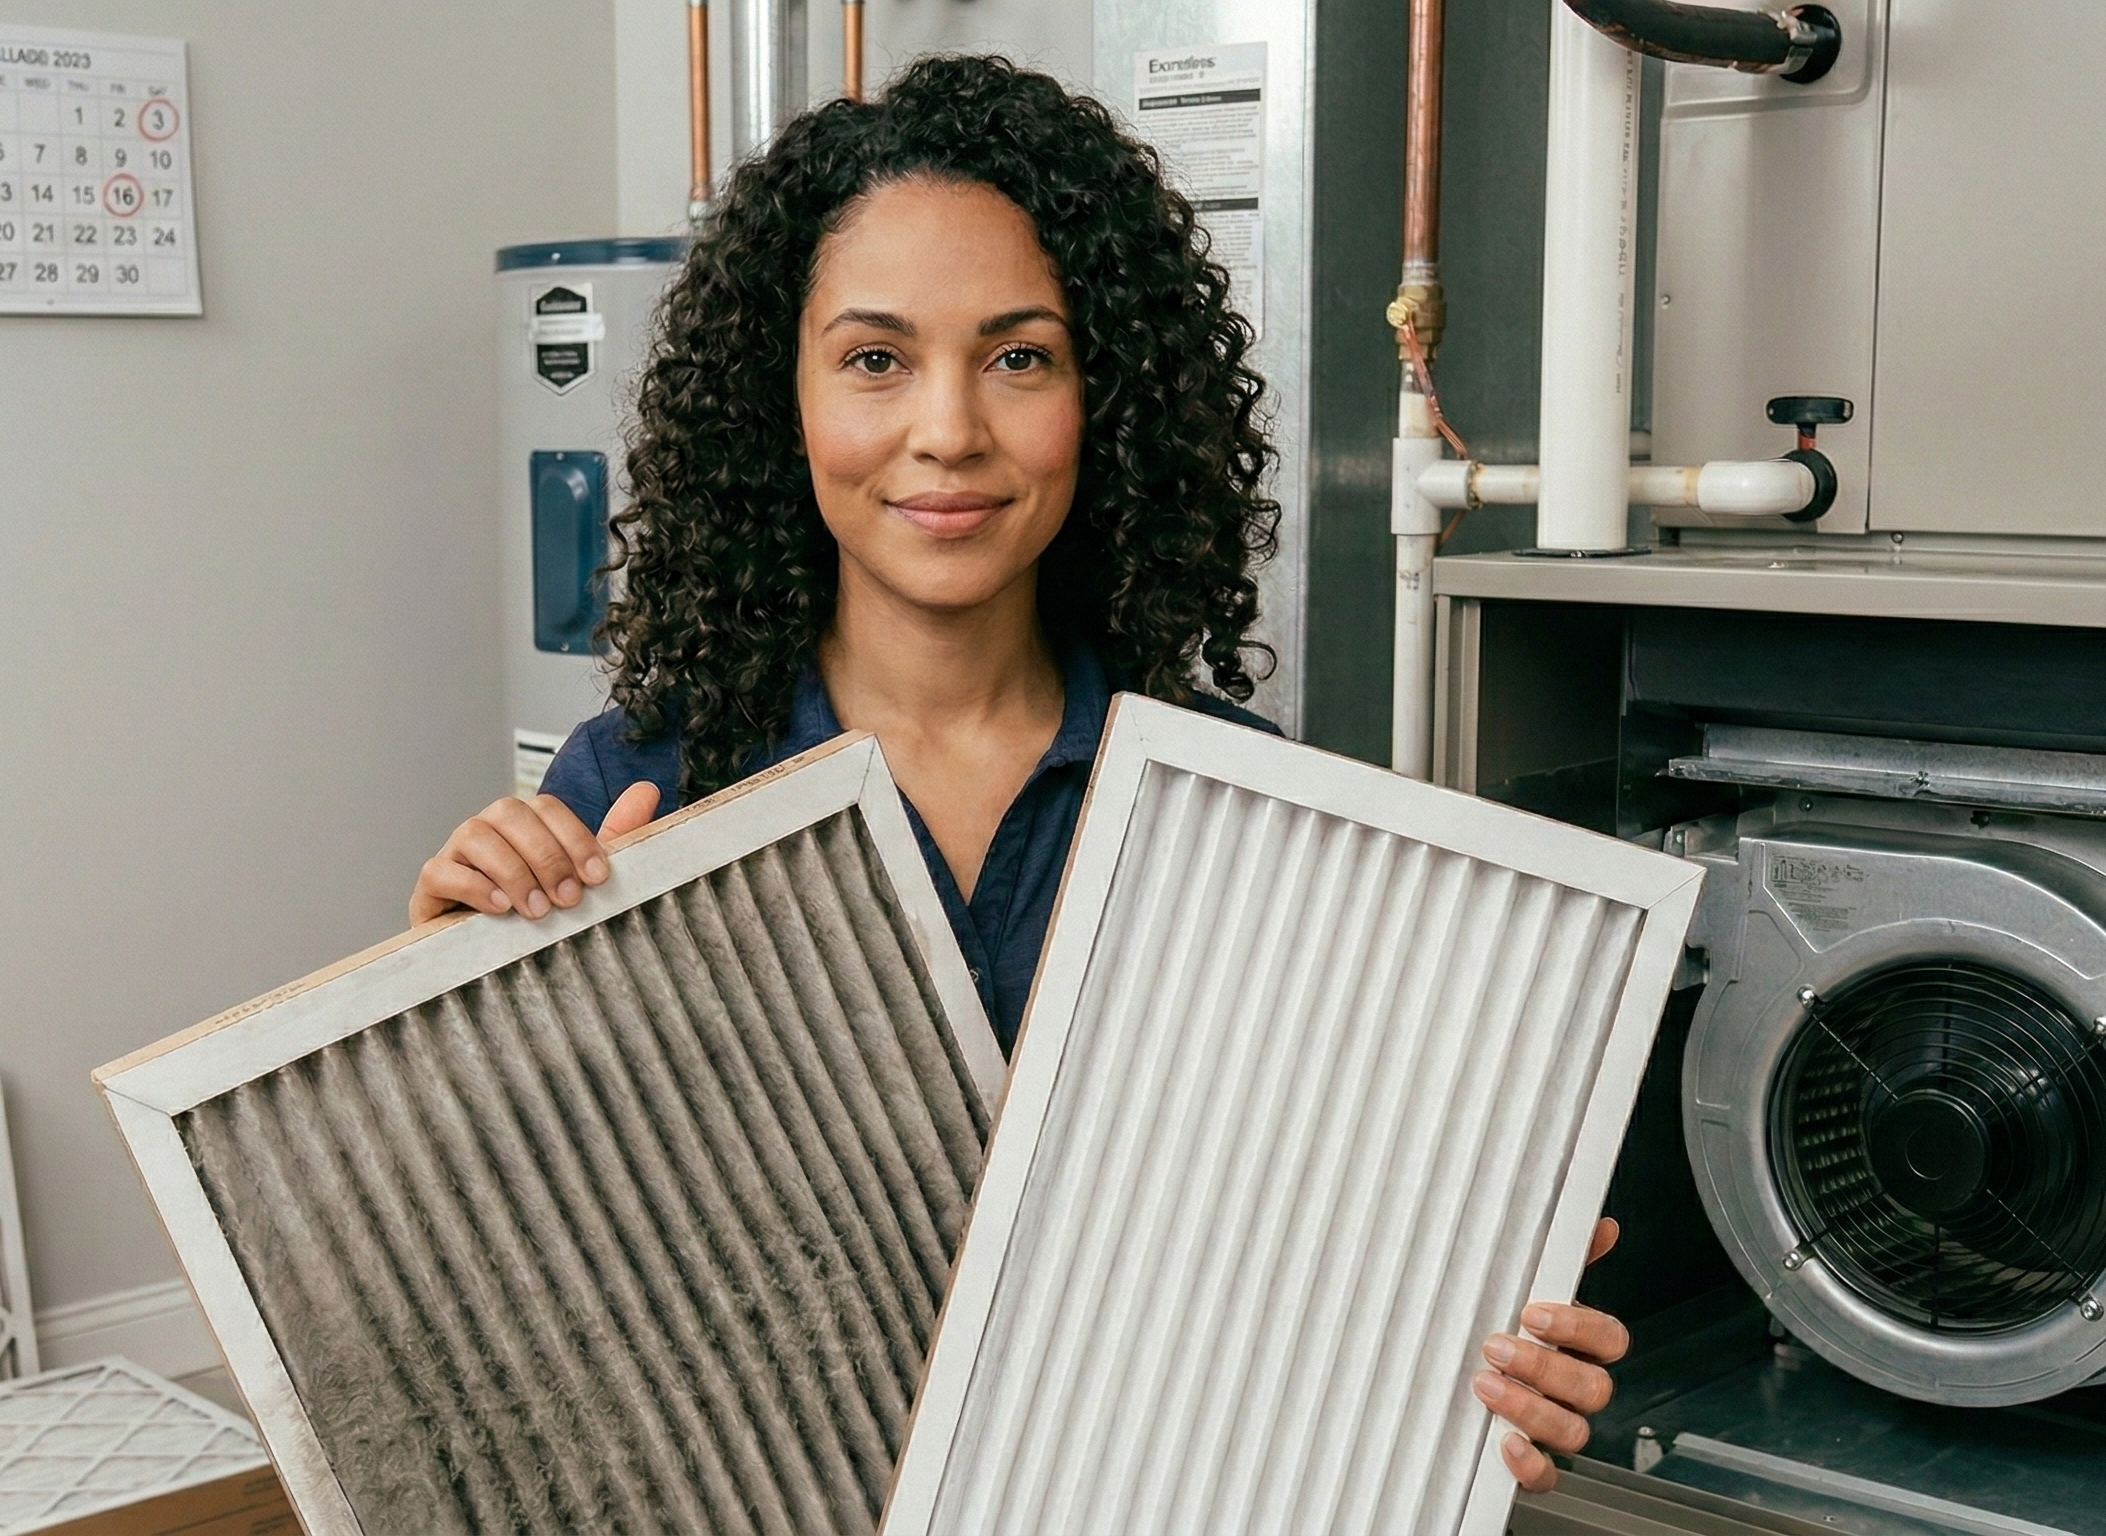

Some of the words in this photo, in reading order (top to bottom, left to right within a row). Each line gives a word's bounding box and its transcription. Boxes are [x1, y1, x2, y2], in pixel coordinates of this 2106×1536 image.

[53, 50, 92, 70] 2023
[74, 106, 83, 125] 1
[114, 108, 126, 128] 2
[152, 109, 165, 131] 3
[34, 143, 46, 163] 7
[74, 145, 88, 166] 8
[114, 148, 128, 168] 9
[149, 149, 173, 171] 10
[0, 181, 13, 202] 3
[31, 184, 54, 203] 14
[72, 186, 96, 205] 15
[113, 187, 135, 206] 16
[152, 189, 174, 208] 17
[0, 221, 15, 242] 0
[32, 222, 54, 243] 21
[74, 224, 97, 245] 22
[113, 225, 138, 246] 23
[153, 227, 176, 246] 24
[34, 262, 59, 283] 28
[76, 263, 100, 284] 29
[116, 264, 140, 284] 30
